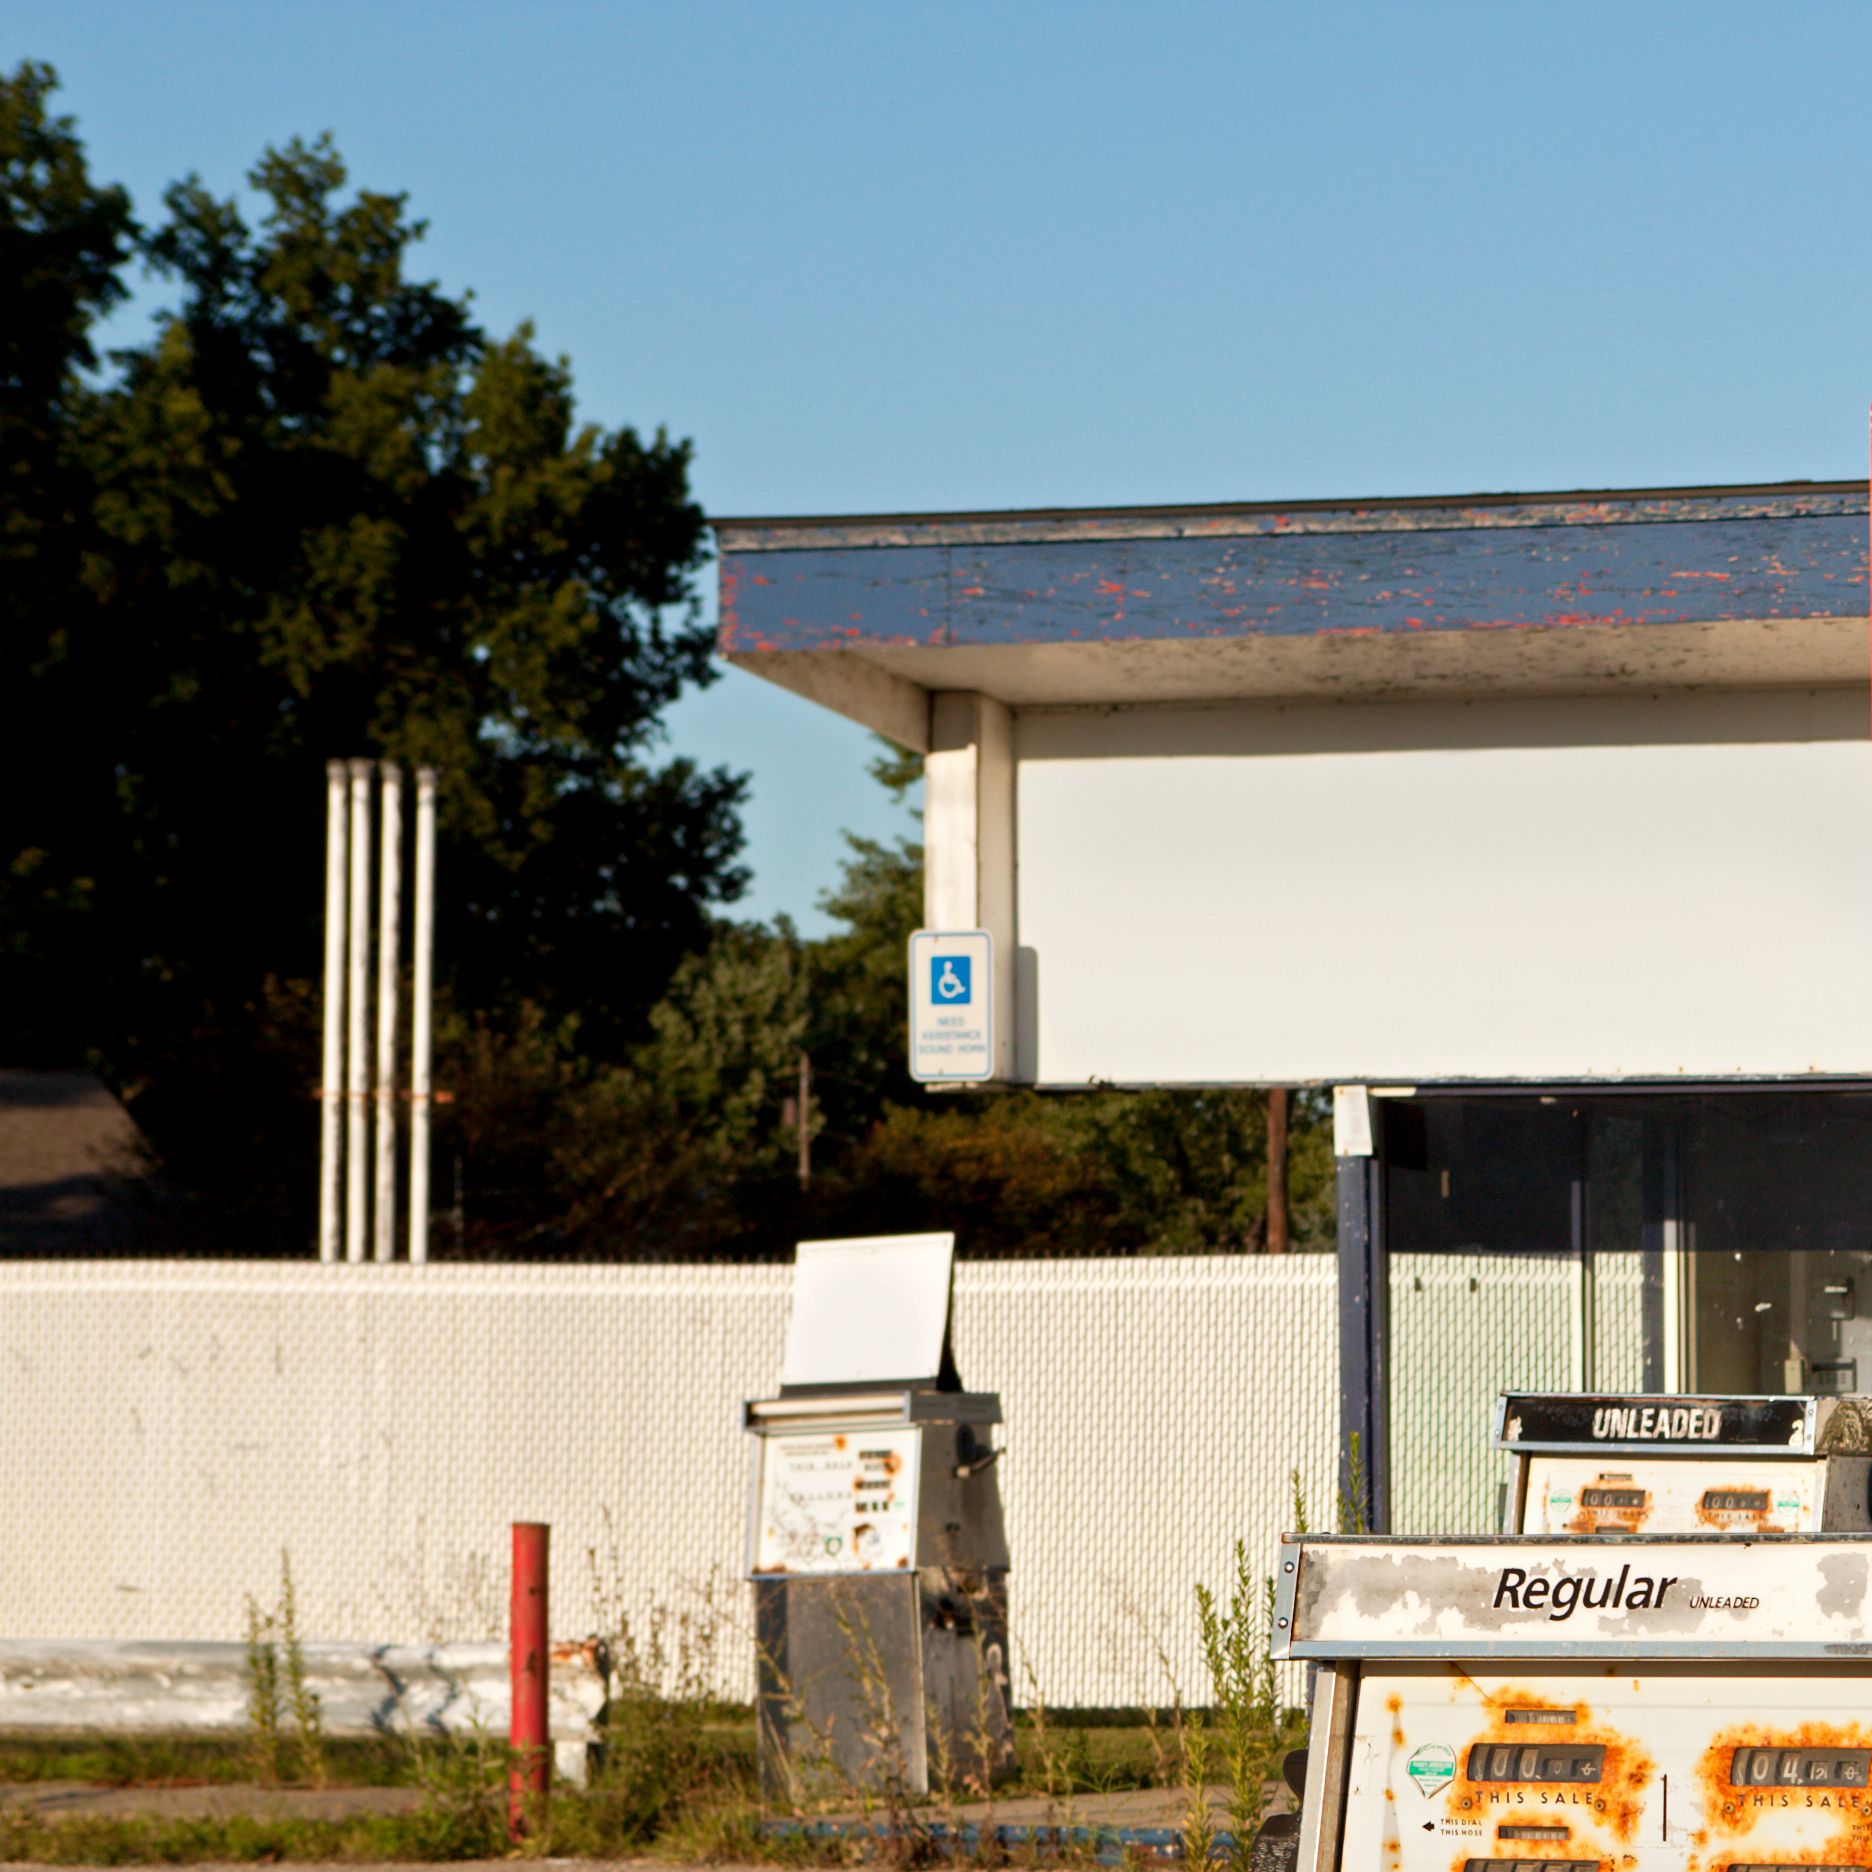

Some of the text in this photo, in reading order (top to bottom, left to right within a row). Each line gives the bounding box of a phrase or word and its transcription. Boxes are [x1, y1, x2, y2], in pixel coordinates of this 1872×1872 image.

[1592, 1408, 1721, 1440] UNLEADED
[1493, 1564, 1760, 1621] Regular UNLEADED
[1475, 1791, 1593, 1805] THIS SALE
[1738, 1795, 1858, 1808] THIS SALE
[1440, 1818, 1459, 1826] THIS
